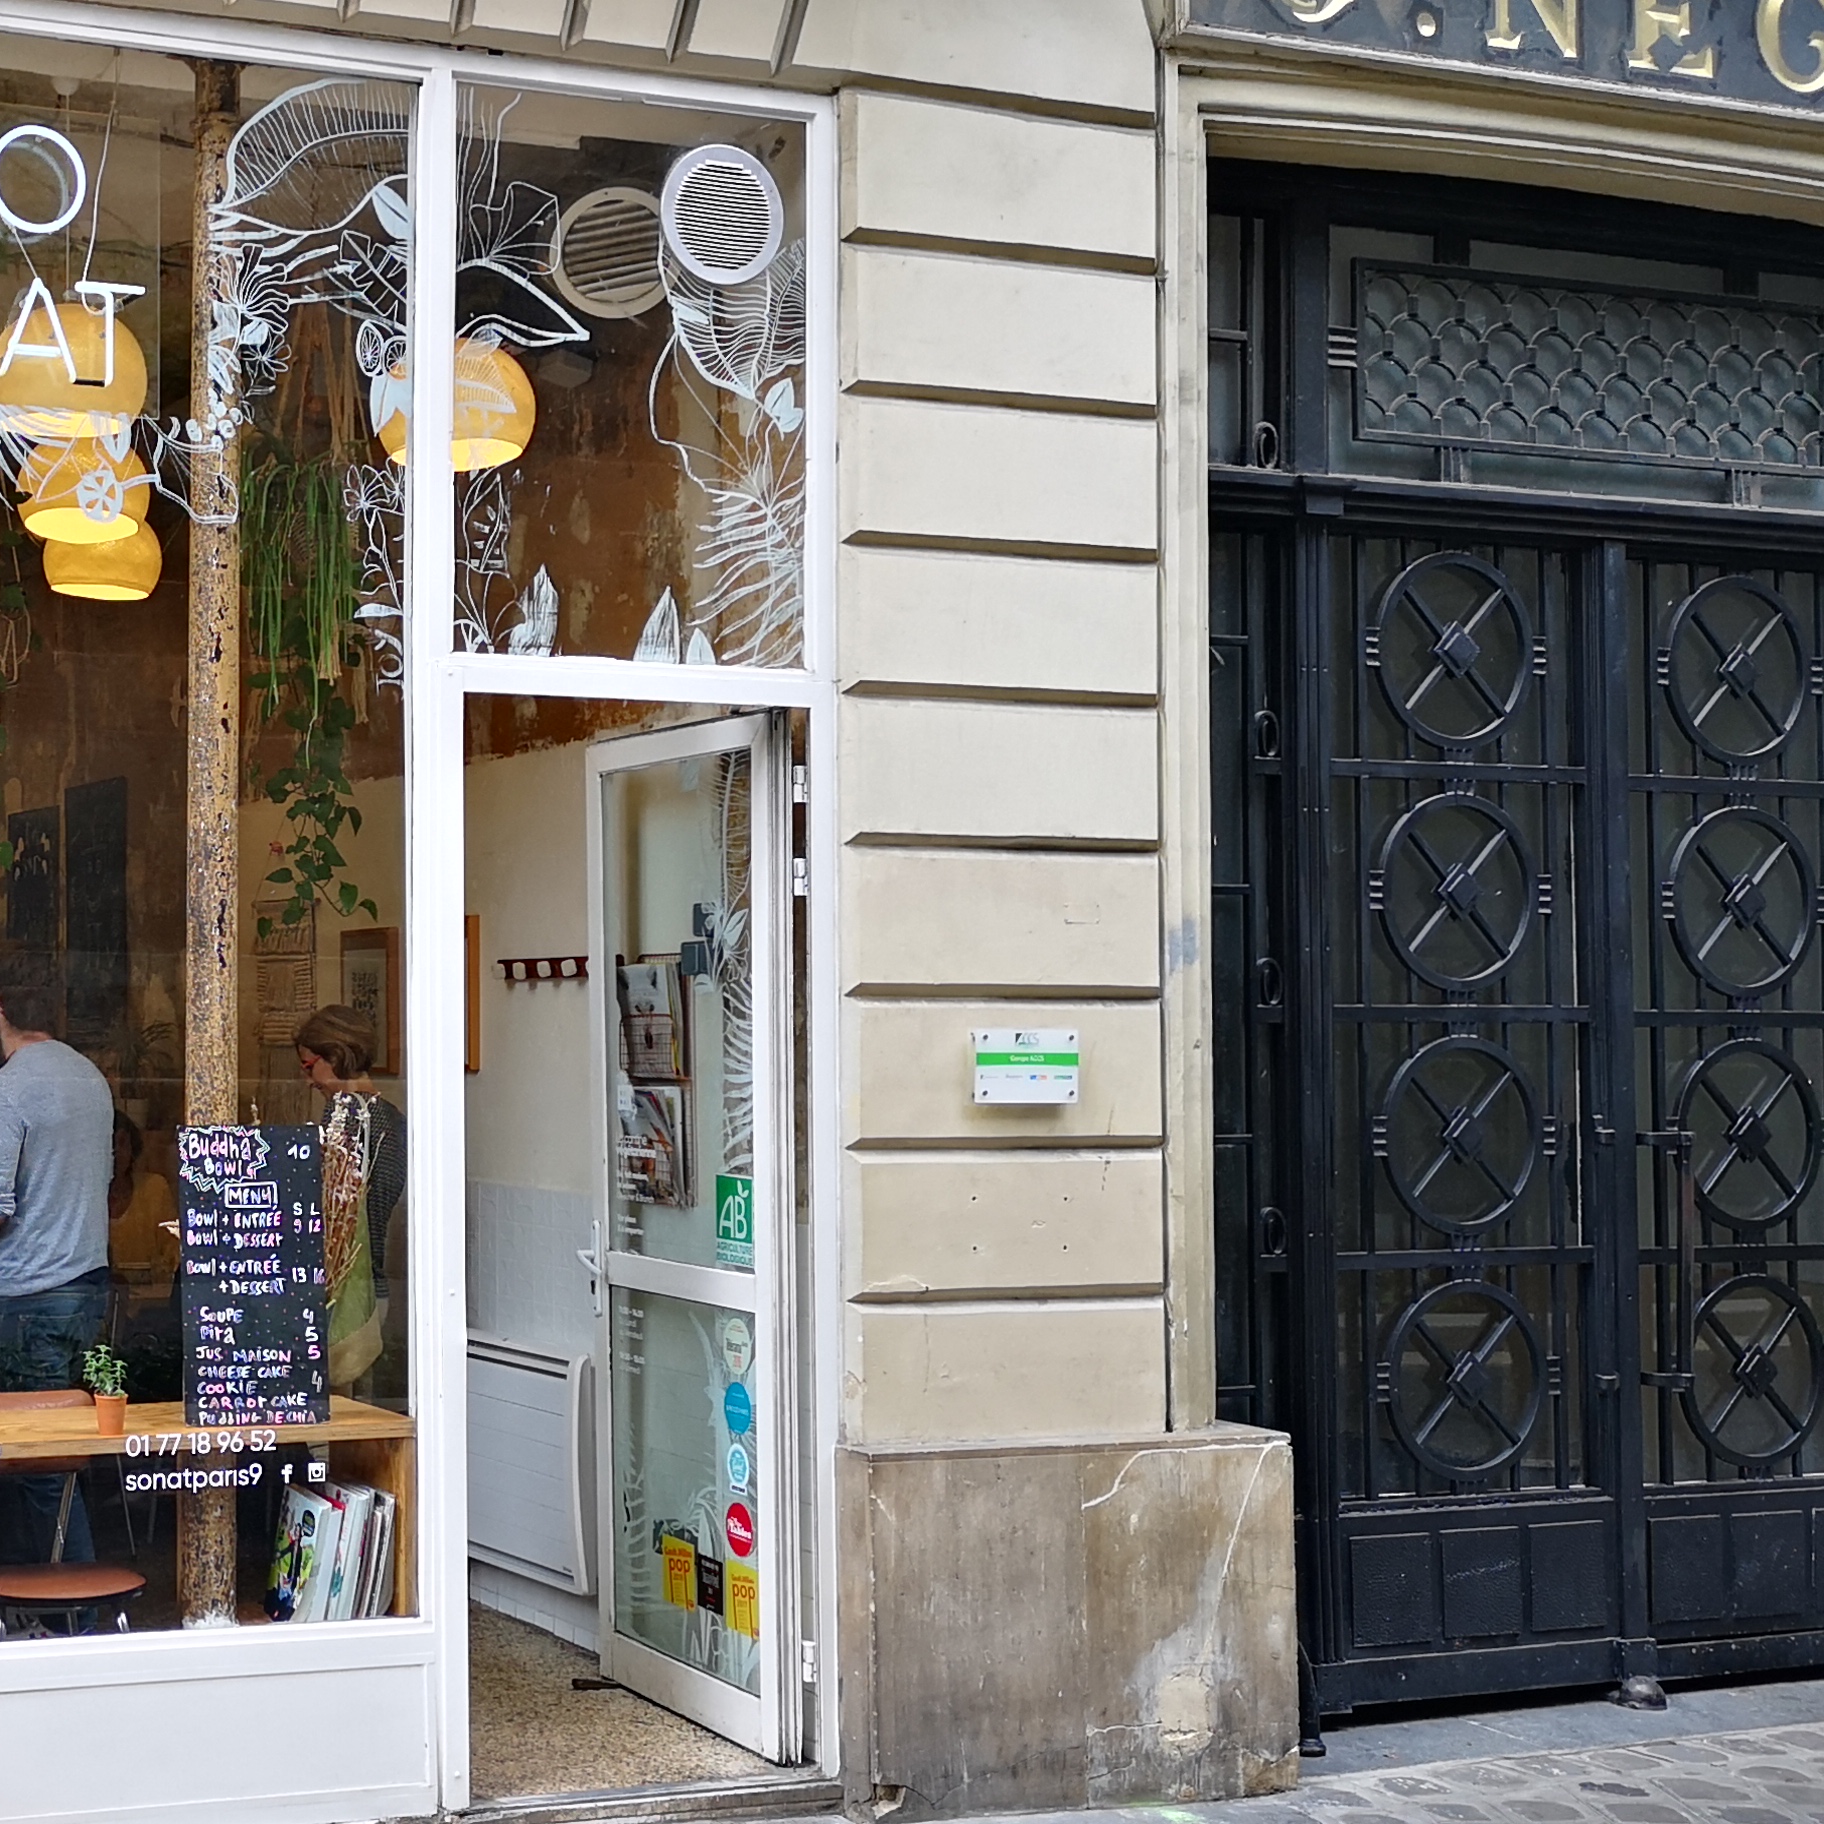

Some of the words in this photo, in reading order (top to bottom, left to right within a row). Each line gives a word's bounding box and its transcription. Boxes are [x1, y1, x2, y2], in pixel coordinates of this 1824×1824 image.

[189, 1132, 252, 1160] Buddha
[287, 1144, 311, 1160] 10
[229, 1187, 272, 1205] MENU
[187, 1208, 218, 1228] Bowl
[293, 1202, 303, 1216] S
[310, 1202, 321, 1216] L
[719, 1194, 748, 1239] AB
[293, 1218, 302, 1234] 9
[186, 1229, 218, 1247] Bowl
[186, 1258, 216, 1277] Bowl
[292, 1267, 307, 1283] 13
[303, 1308, 314, 1324] 4
[305, 1326, 318, 1342] 5
[196, 1346, 223, 1361] JUS
[308, 1345, 321, 1360] 5
[257, 1364, 292, 1378] CAKE
[311, 1370, 323, 1393] 4
[271, 1392, 308, 1408] CAKE
[126, 1434, 150, 1457] 01
[155, 1433, 182, 1456] 77
[187, 1432, 211, 1455] 18
[217, 1431, 244, 1453] 96
[250, 1429, 277, 1452] 52
[126, 1462, 263, 1493] sonatparis9
